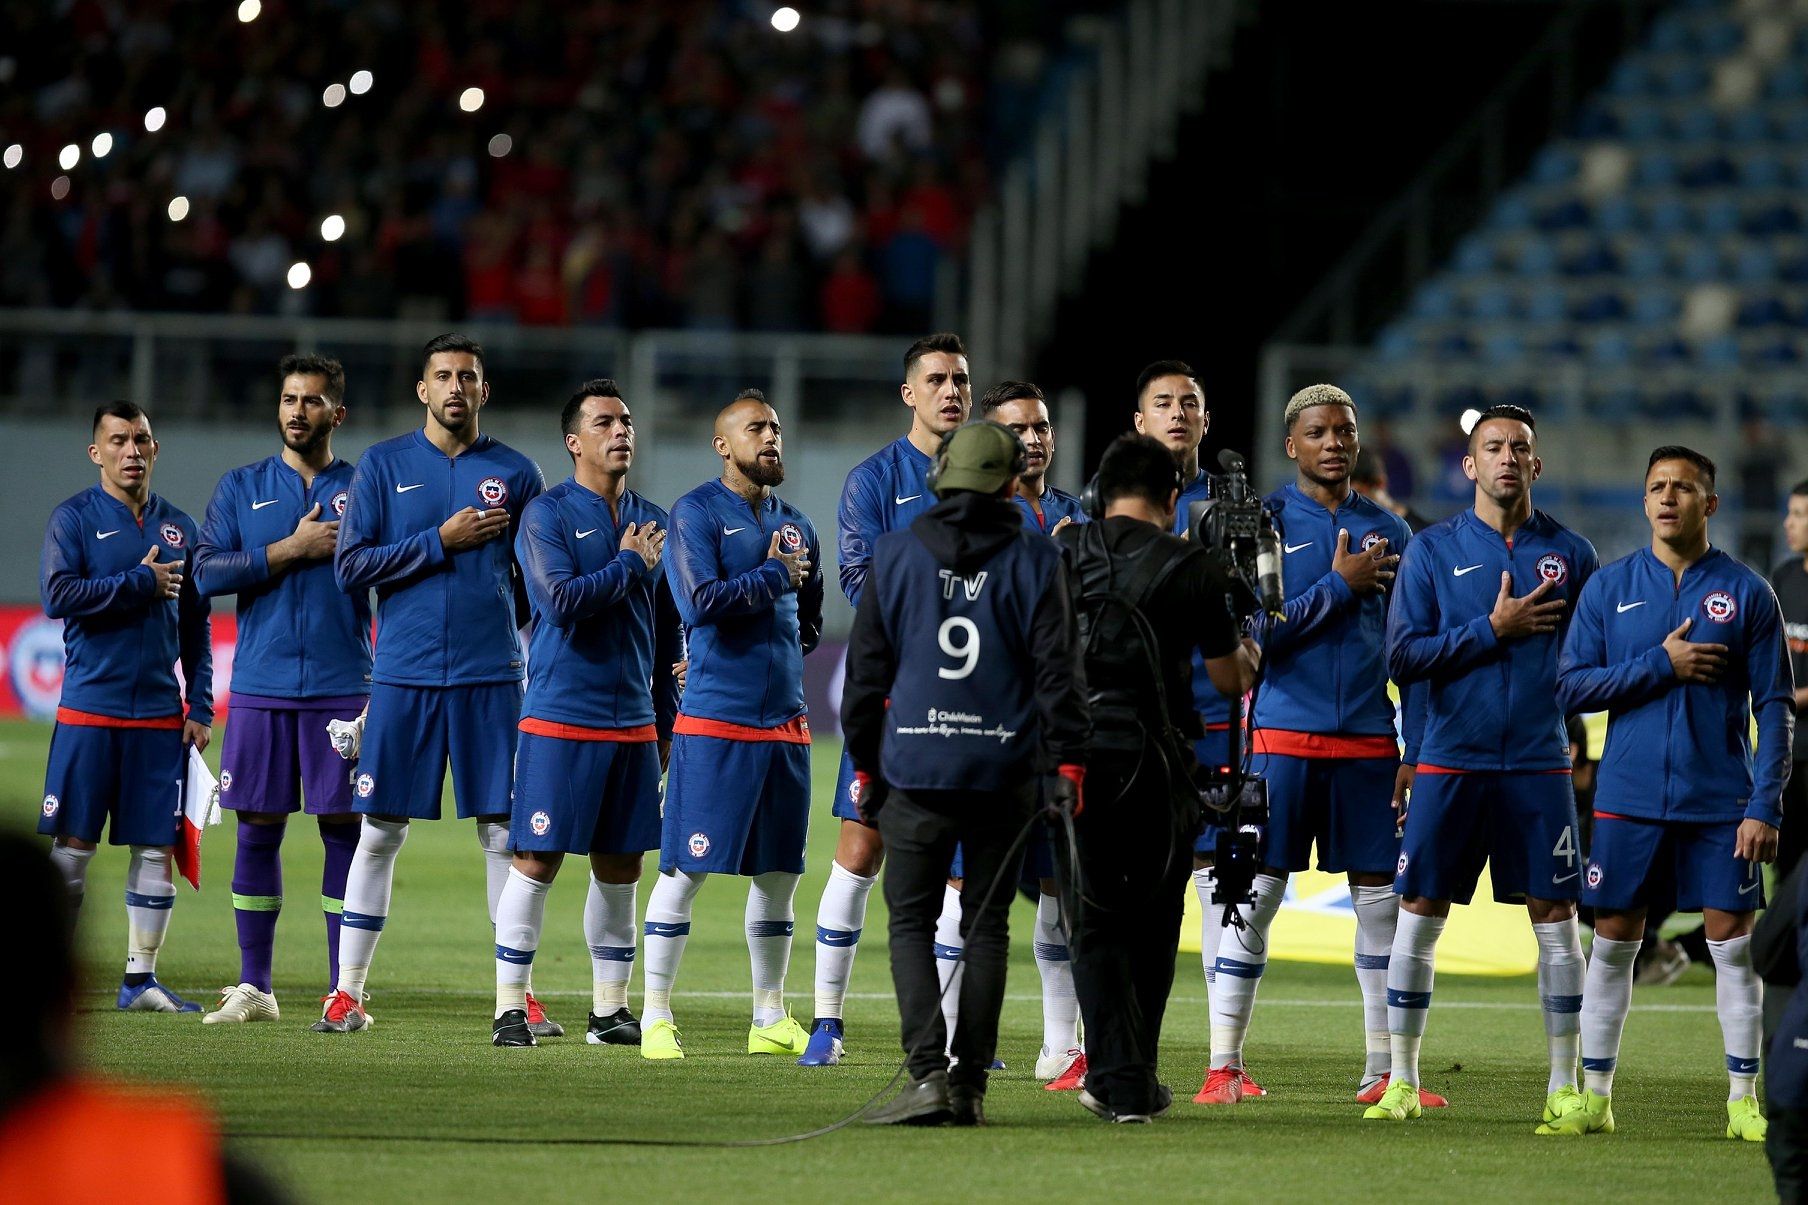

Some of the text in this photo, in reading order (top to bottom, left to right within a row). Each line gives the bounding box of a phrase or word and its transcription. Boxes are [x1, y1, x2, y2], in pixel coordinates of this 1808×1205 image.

[938, 568, 988, 601] TV
[937, 615, 981, 680] 9
[1552, 825, 1576, 868] 4
